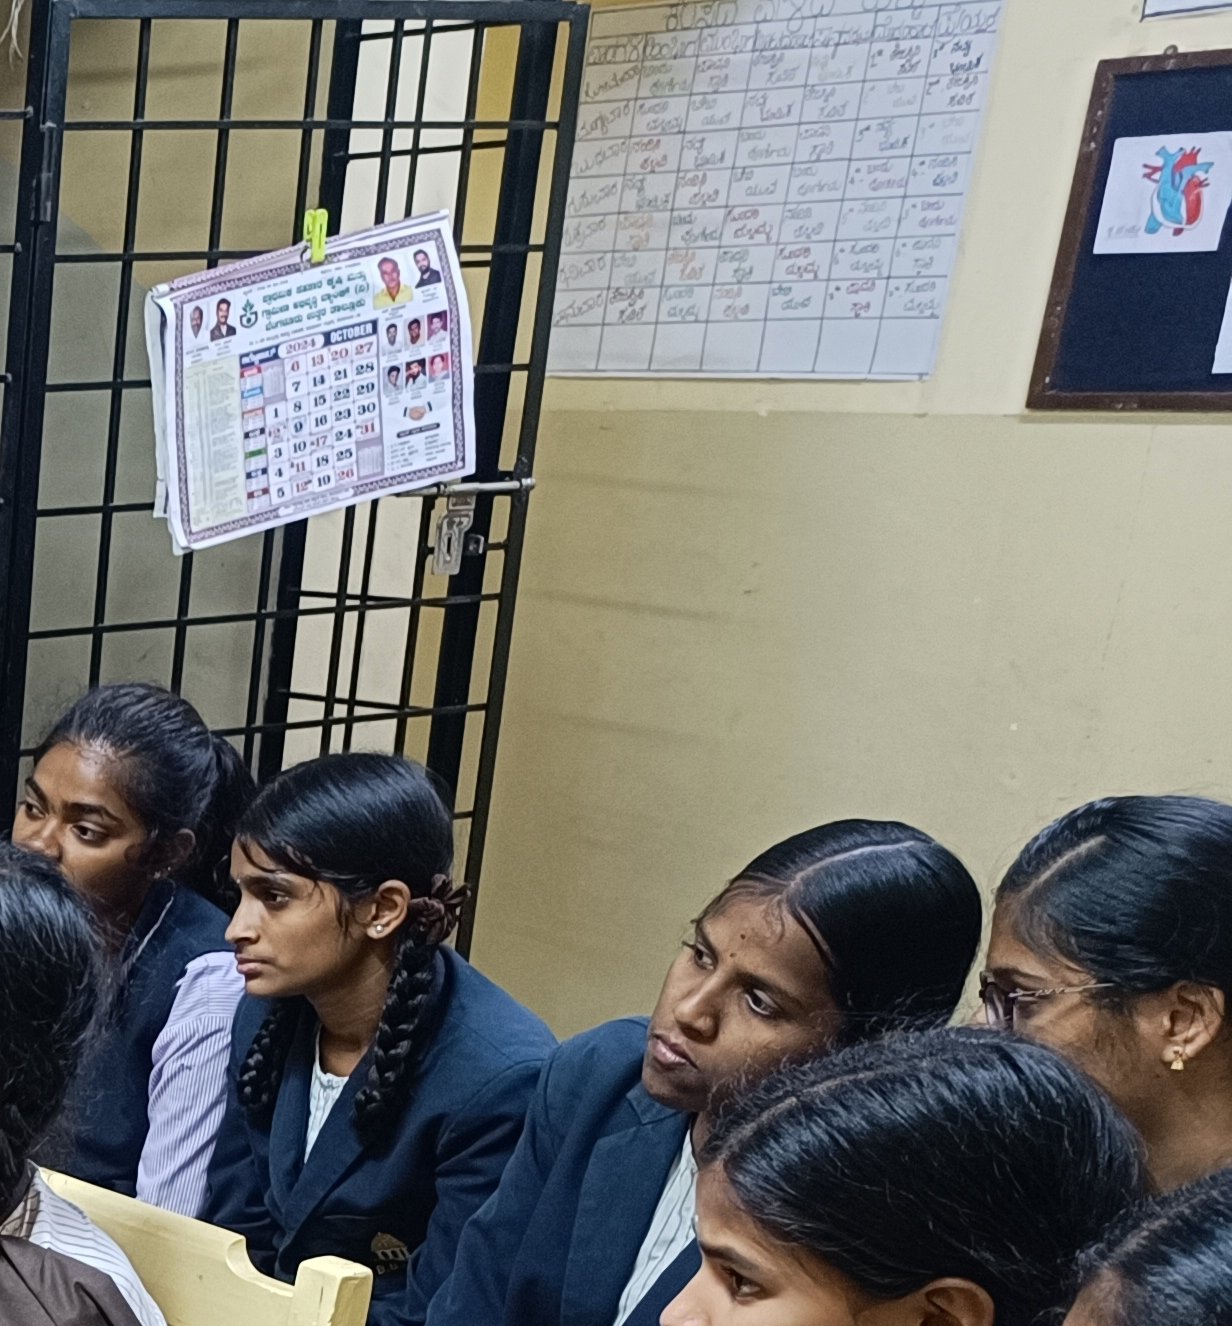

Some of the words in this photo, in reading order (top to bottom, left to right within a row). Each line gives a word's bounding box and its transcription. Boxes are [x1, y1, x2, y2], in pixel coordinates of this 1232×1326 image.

[286, 338, 316, 354] 2024
[330, 322, 373, 343] OCTOBER
[312, 354, 324, 367] 13
[330, 348, 348, 361] 20
[355, 341, 374, 356] 27
[292, 380, 300, 392] 7
[312, 374, 325, 387] 14
[334, 368, 348, 381] 21
[356, 362, 374, 376] 28
[274, 407, 278, 418] 1
[293, 400, 302, 413] 8
[314, 394, 326, 408] 15
[333, 388, 350, 402] 22
[356, 382, 375, 396] 29
[294, 421, 303, 433] 9
[314, 414, 328, 427] 16
[334, 408, 351, 422] 23
[357, 402, 376, 415] 30
[274, 447, 282, 458] 3
[293, 441, 306, 454] 10
[315, 435, 328, 447] 17
[335, 428, 353, 442] 24
[275, 467, 283, 478] 4
[296, 461, 305, 472] 11
[316, 455, 329, 468] 18
[336, 448, 353, 461] 25
[277, 487, 284, 498] 5
[296, 482, 308, 493] 12
[317, 475, 331, 487] 19
[338, 469, 354, 480] 26
